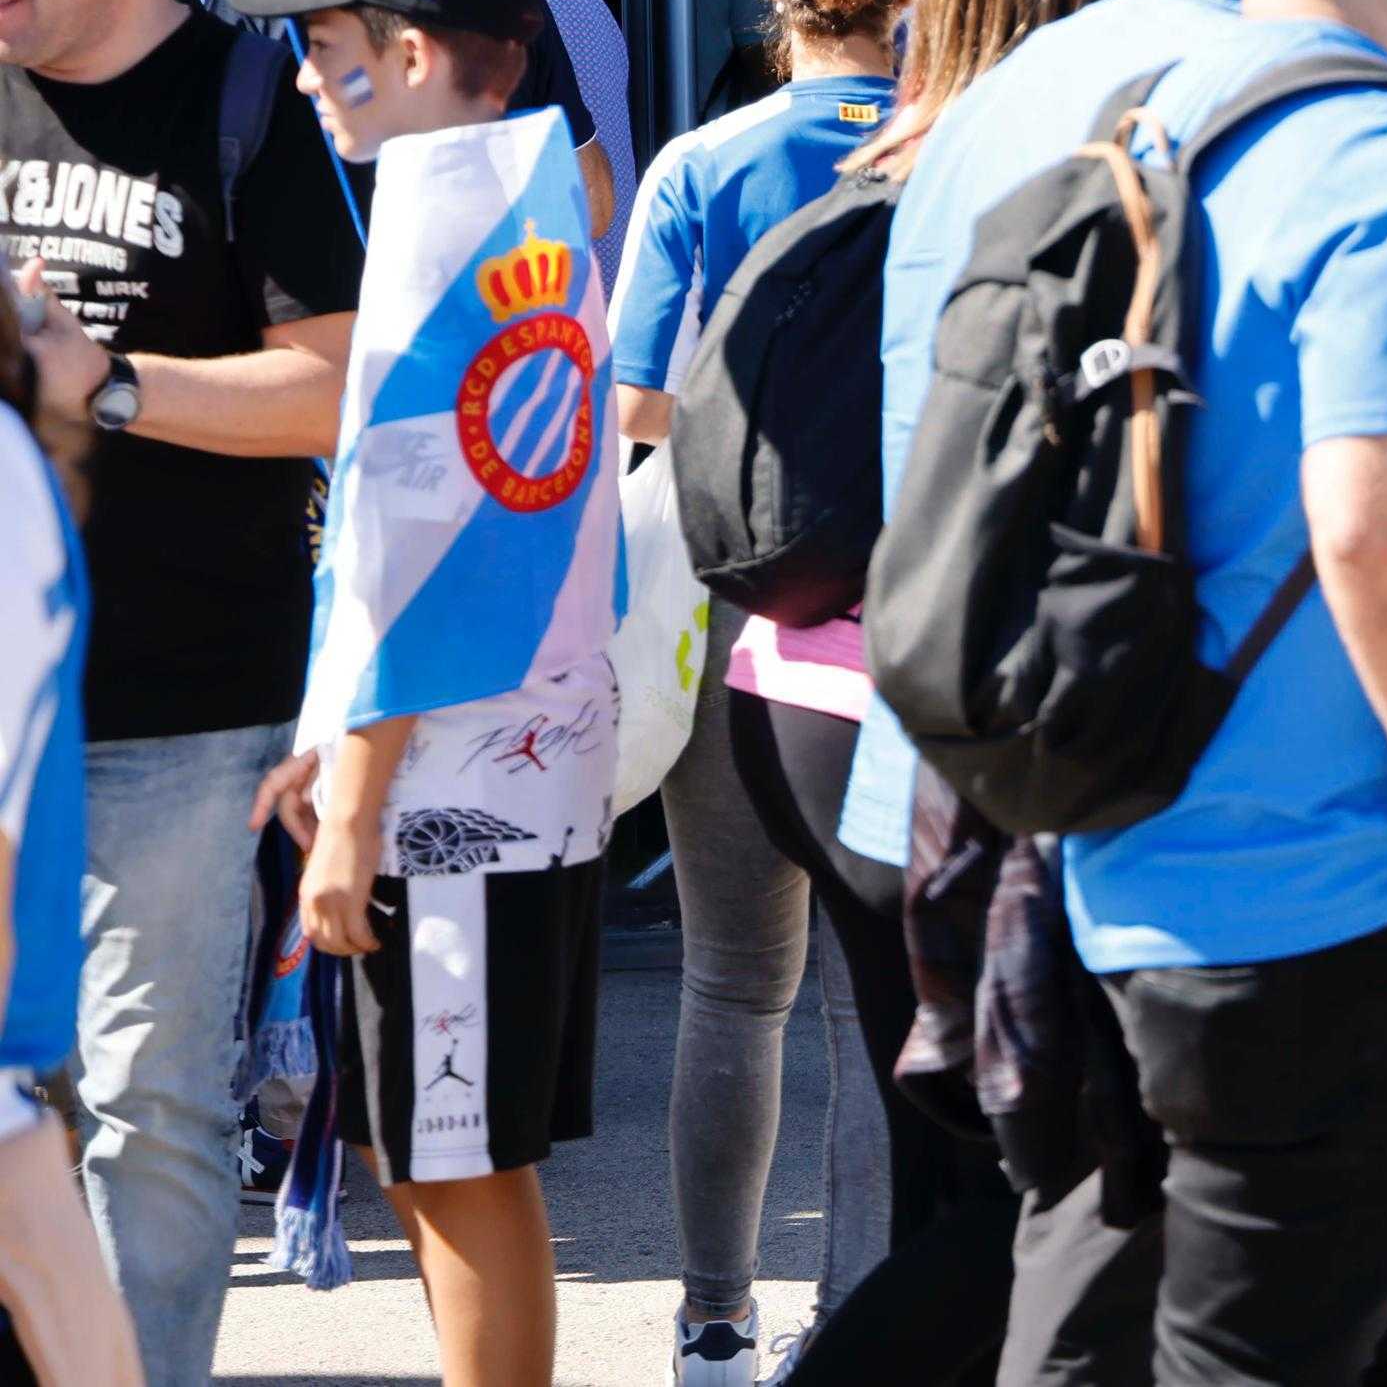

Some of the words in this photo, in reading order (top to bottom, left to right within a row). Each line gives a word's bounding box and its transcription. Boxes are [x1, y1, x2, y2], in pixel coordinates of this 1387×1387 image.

[461, 356, 497, 416] RCD
[500, 319, 597, 379] ESPANYO
[469, 440, 499, 480] DE
